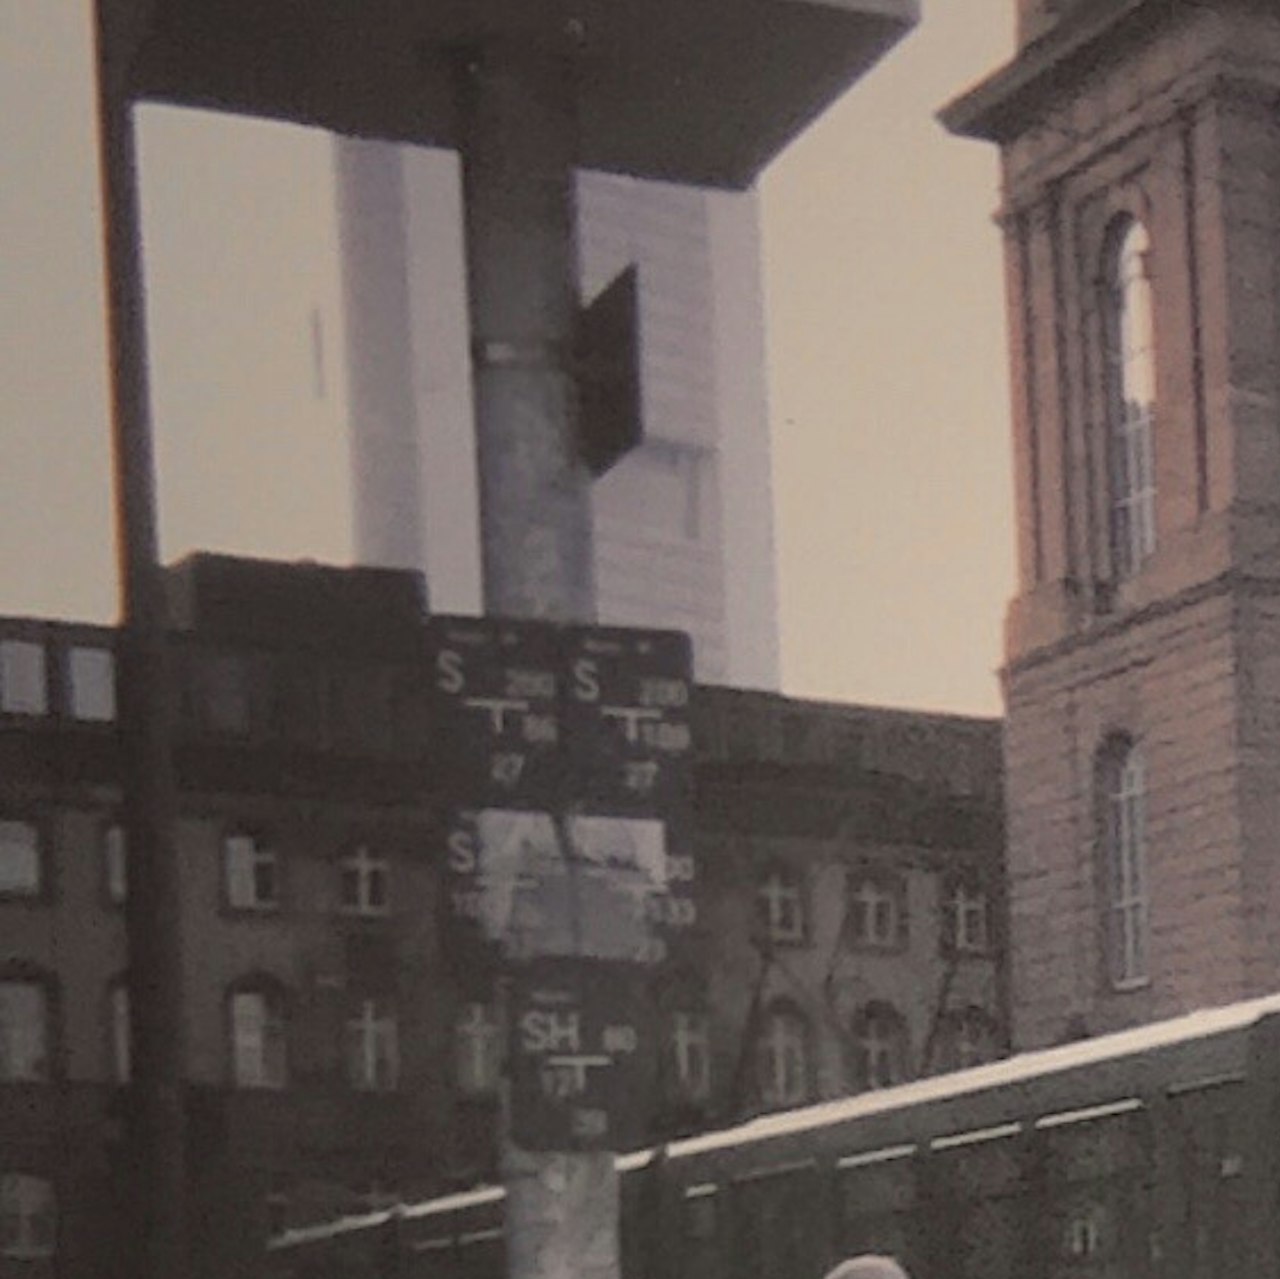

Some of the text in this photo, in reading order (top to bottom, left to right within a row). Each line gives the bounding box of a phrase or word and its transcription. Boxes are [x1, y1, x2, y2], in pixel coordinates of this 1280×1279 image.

[437, 650, 466, 693] S
[573, 660, 600, 701] S
[446, 831, 475, 872] S
[520, 1011, 580, 1051] SH
